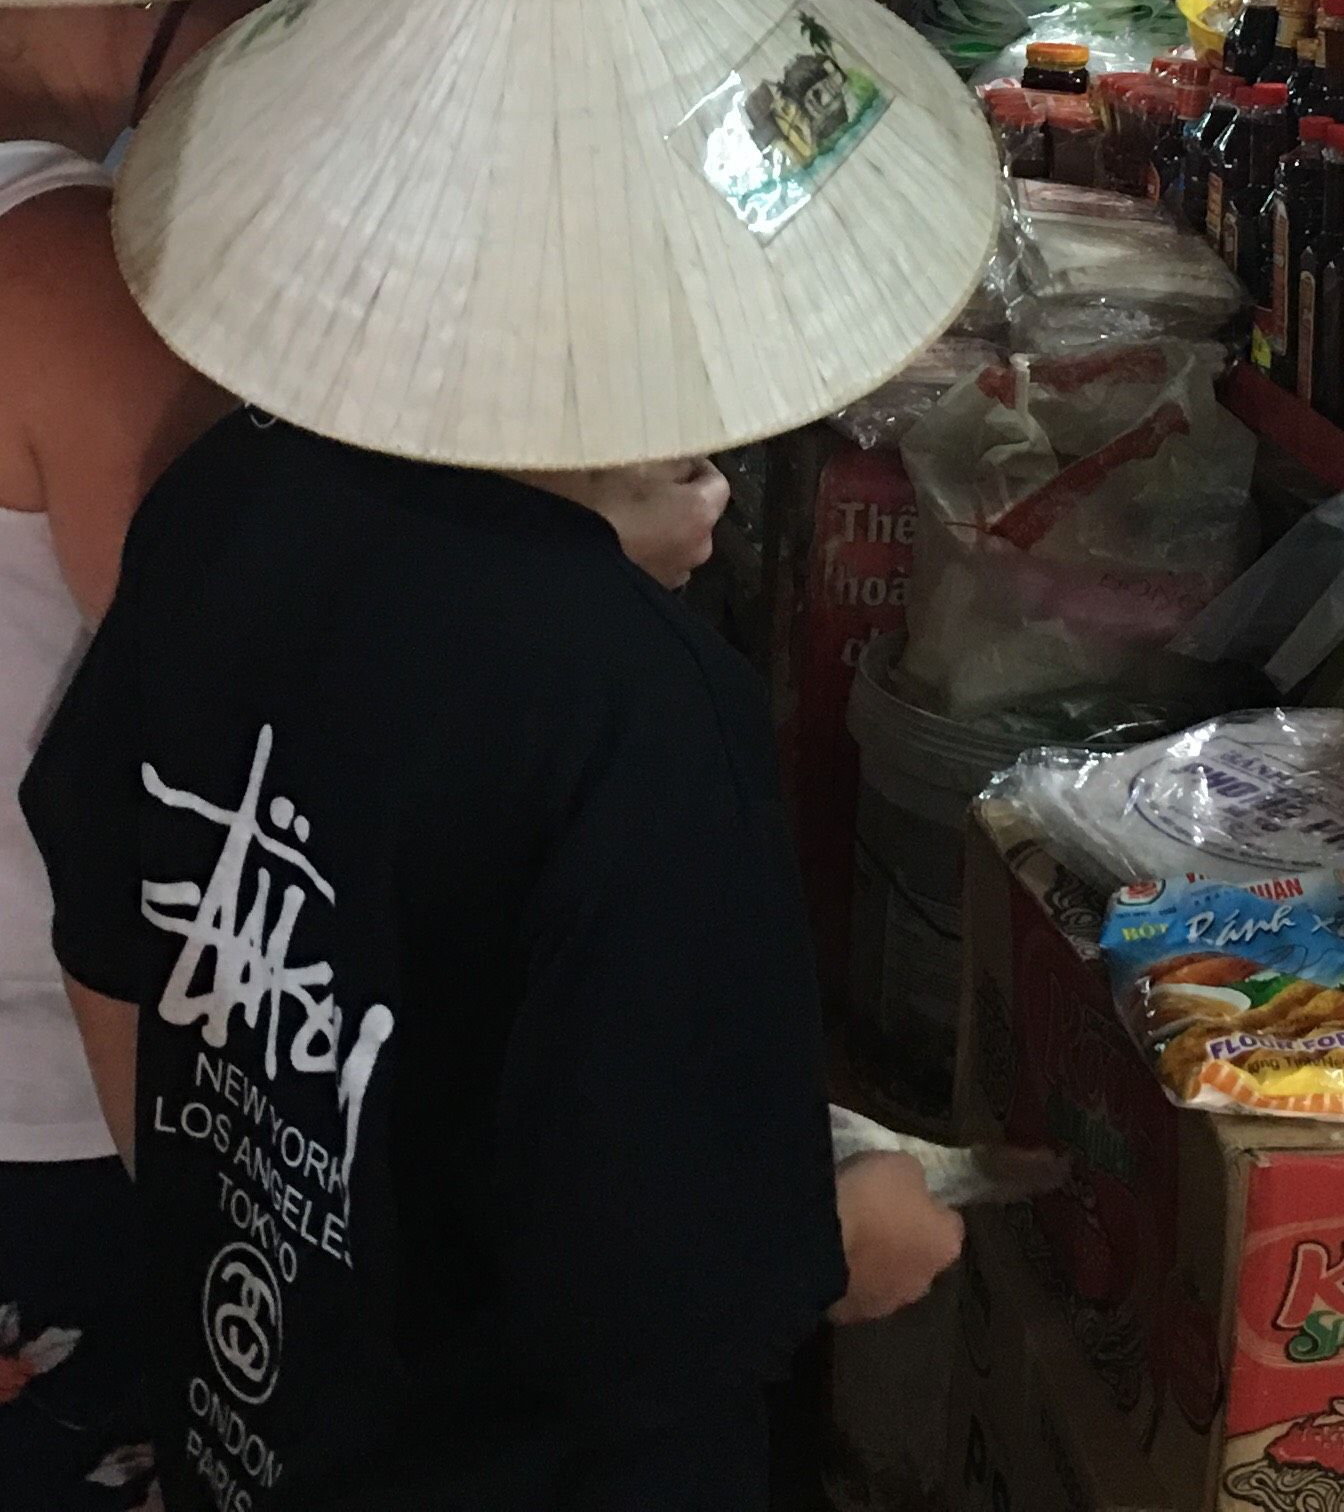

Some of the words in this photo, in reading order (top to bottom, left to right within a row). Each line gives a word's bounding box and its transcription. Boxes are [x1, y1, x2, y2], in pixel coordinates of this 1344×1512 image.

[1209, 1031, 1296, 1060] FLOUR
[155, 1095, 233, 1154] LOS
[195, 1051, 268, 1126] NEW
[268, 1103, 348, 1194] YORK
[217, 1170, 298, 1283] TOKYO
[188, 1376, 284, 1489] ONDON
